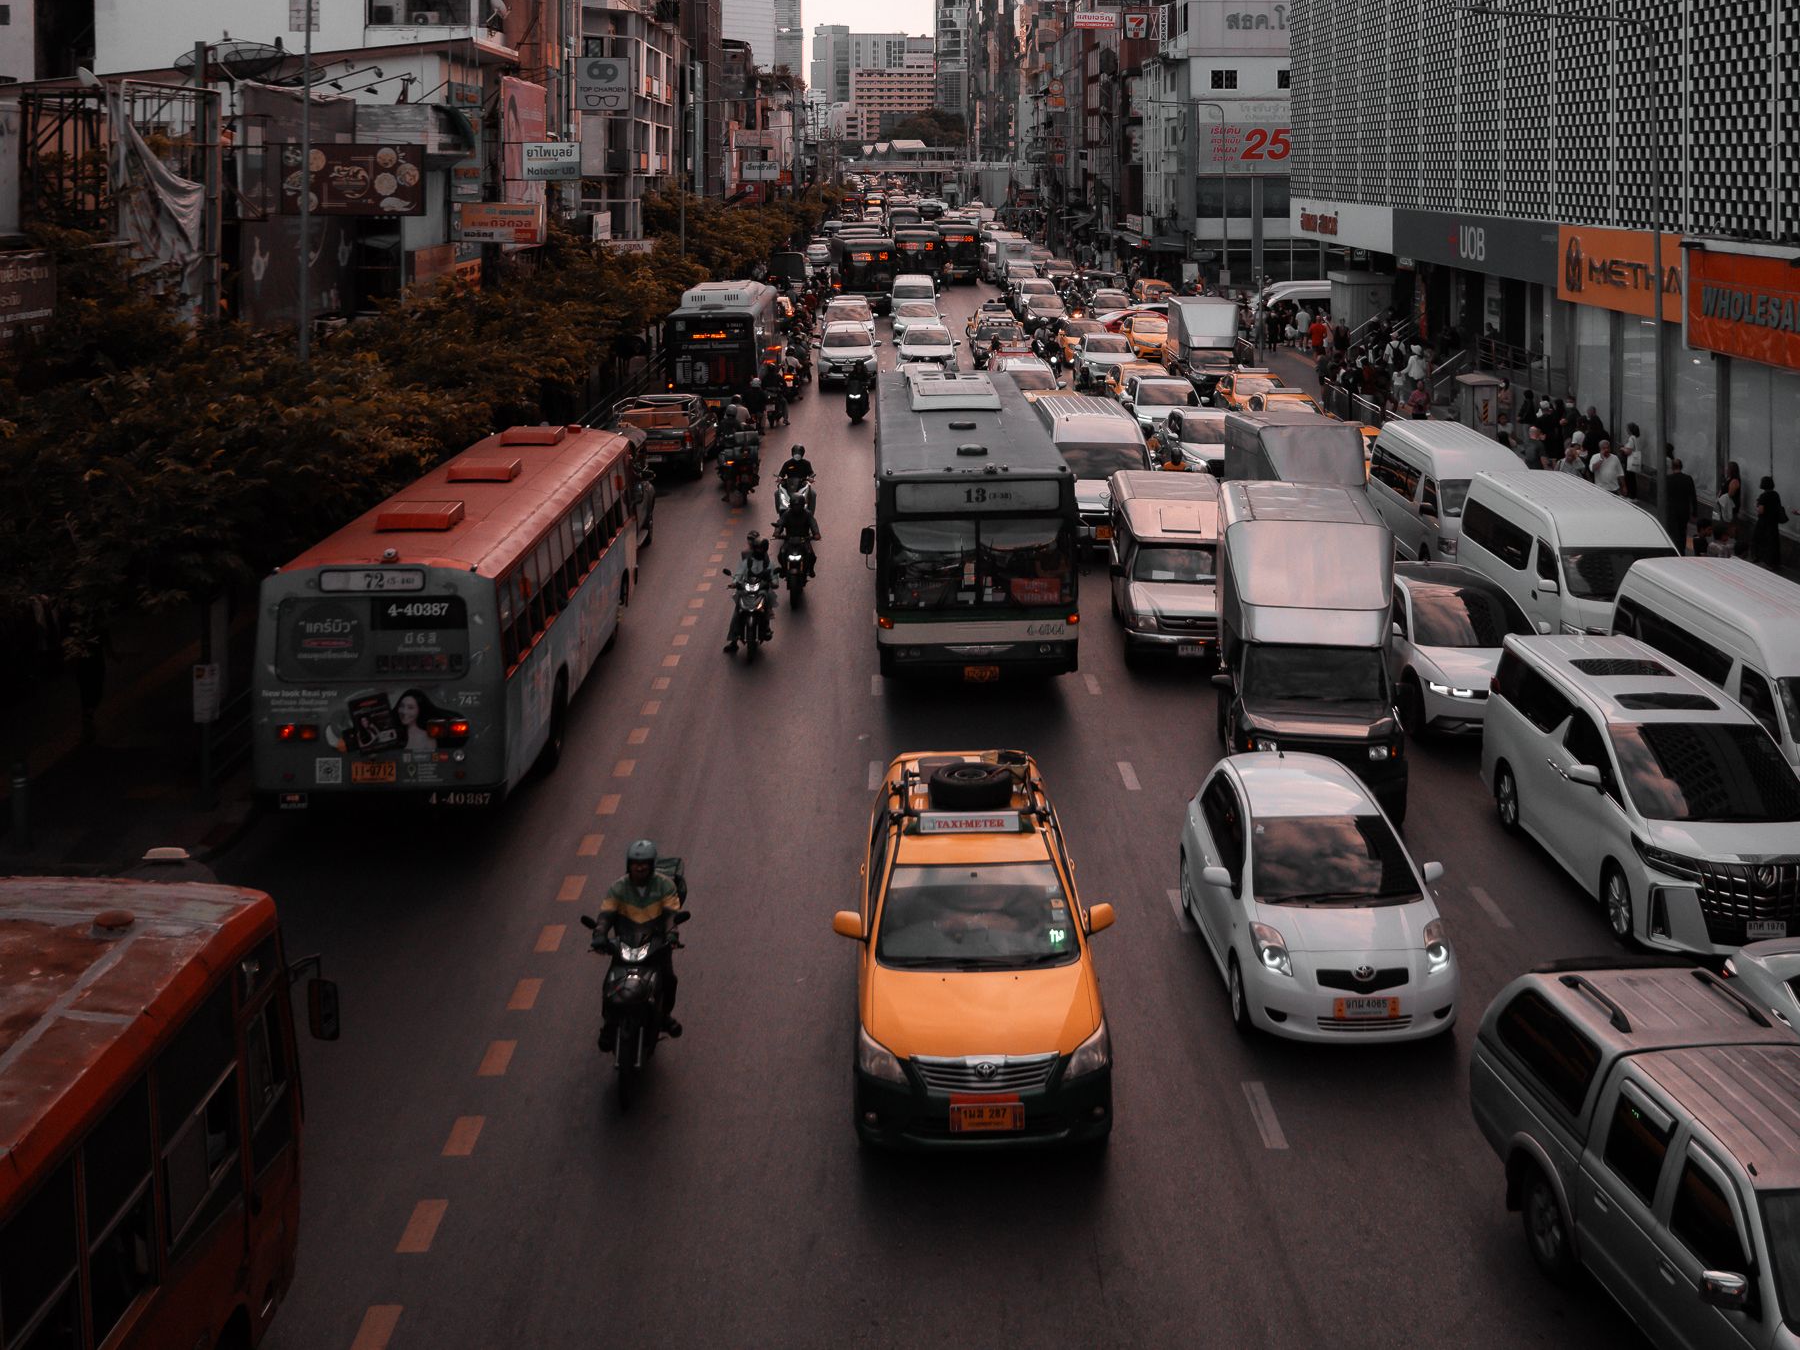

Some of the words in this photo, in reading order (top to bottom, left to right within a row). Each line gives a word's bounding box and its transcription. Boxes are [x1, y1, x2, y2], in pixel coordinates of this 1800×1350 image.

[1240, 128, 1290, 160] 25
[526, 144, 575, 161] ยาไพบูลย์
[1460, 225, 1485, 261] UOB
[964, 488, 987, 503] 13
[364, 574, 385, 589] 72
[387, 603, 450, 618] 4-40387
[935, 818, 1005, 829] TAXI-METER
